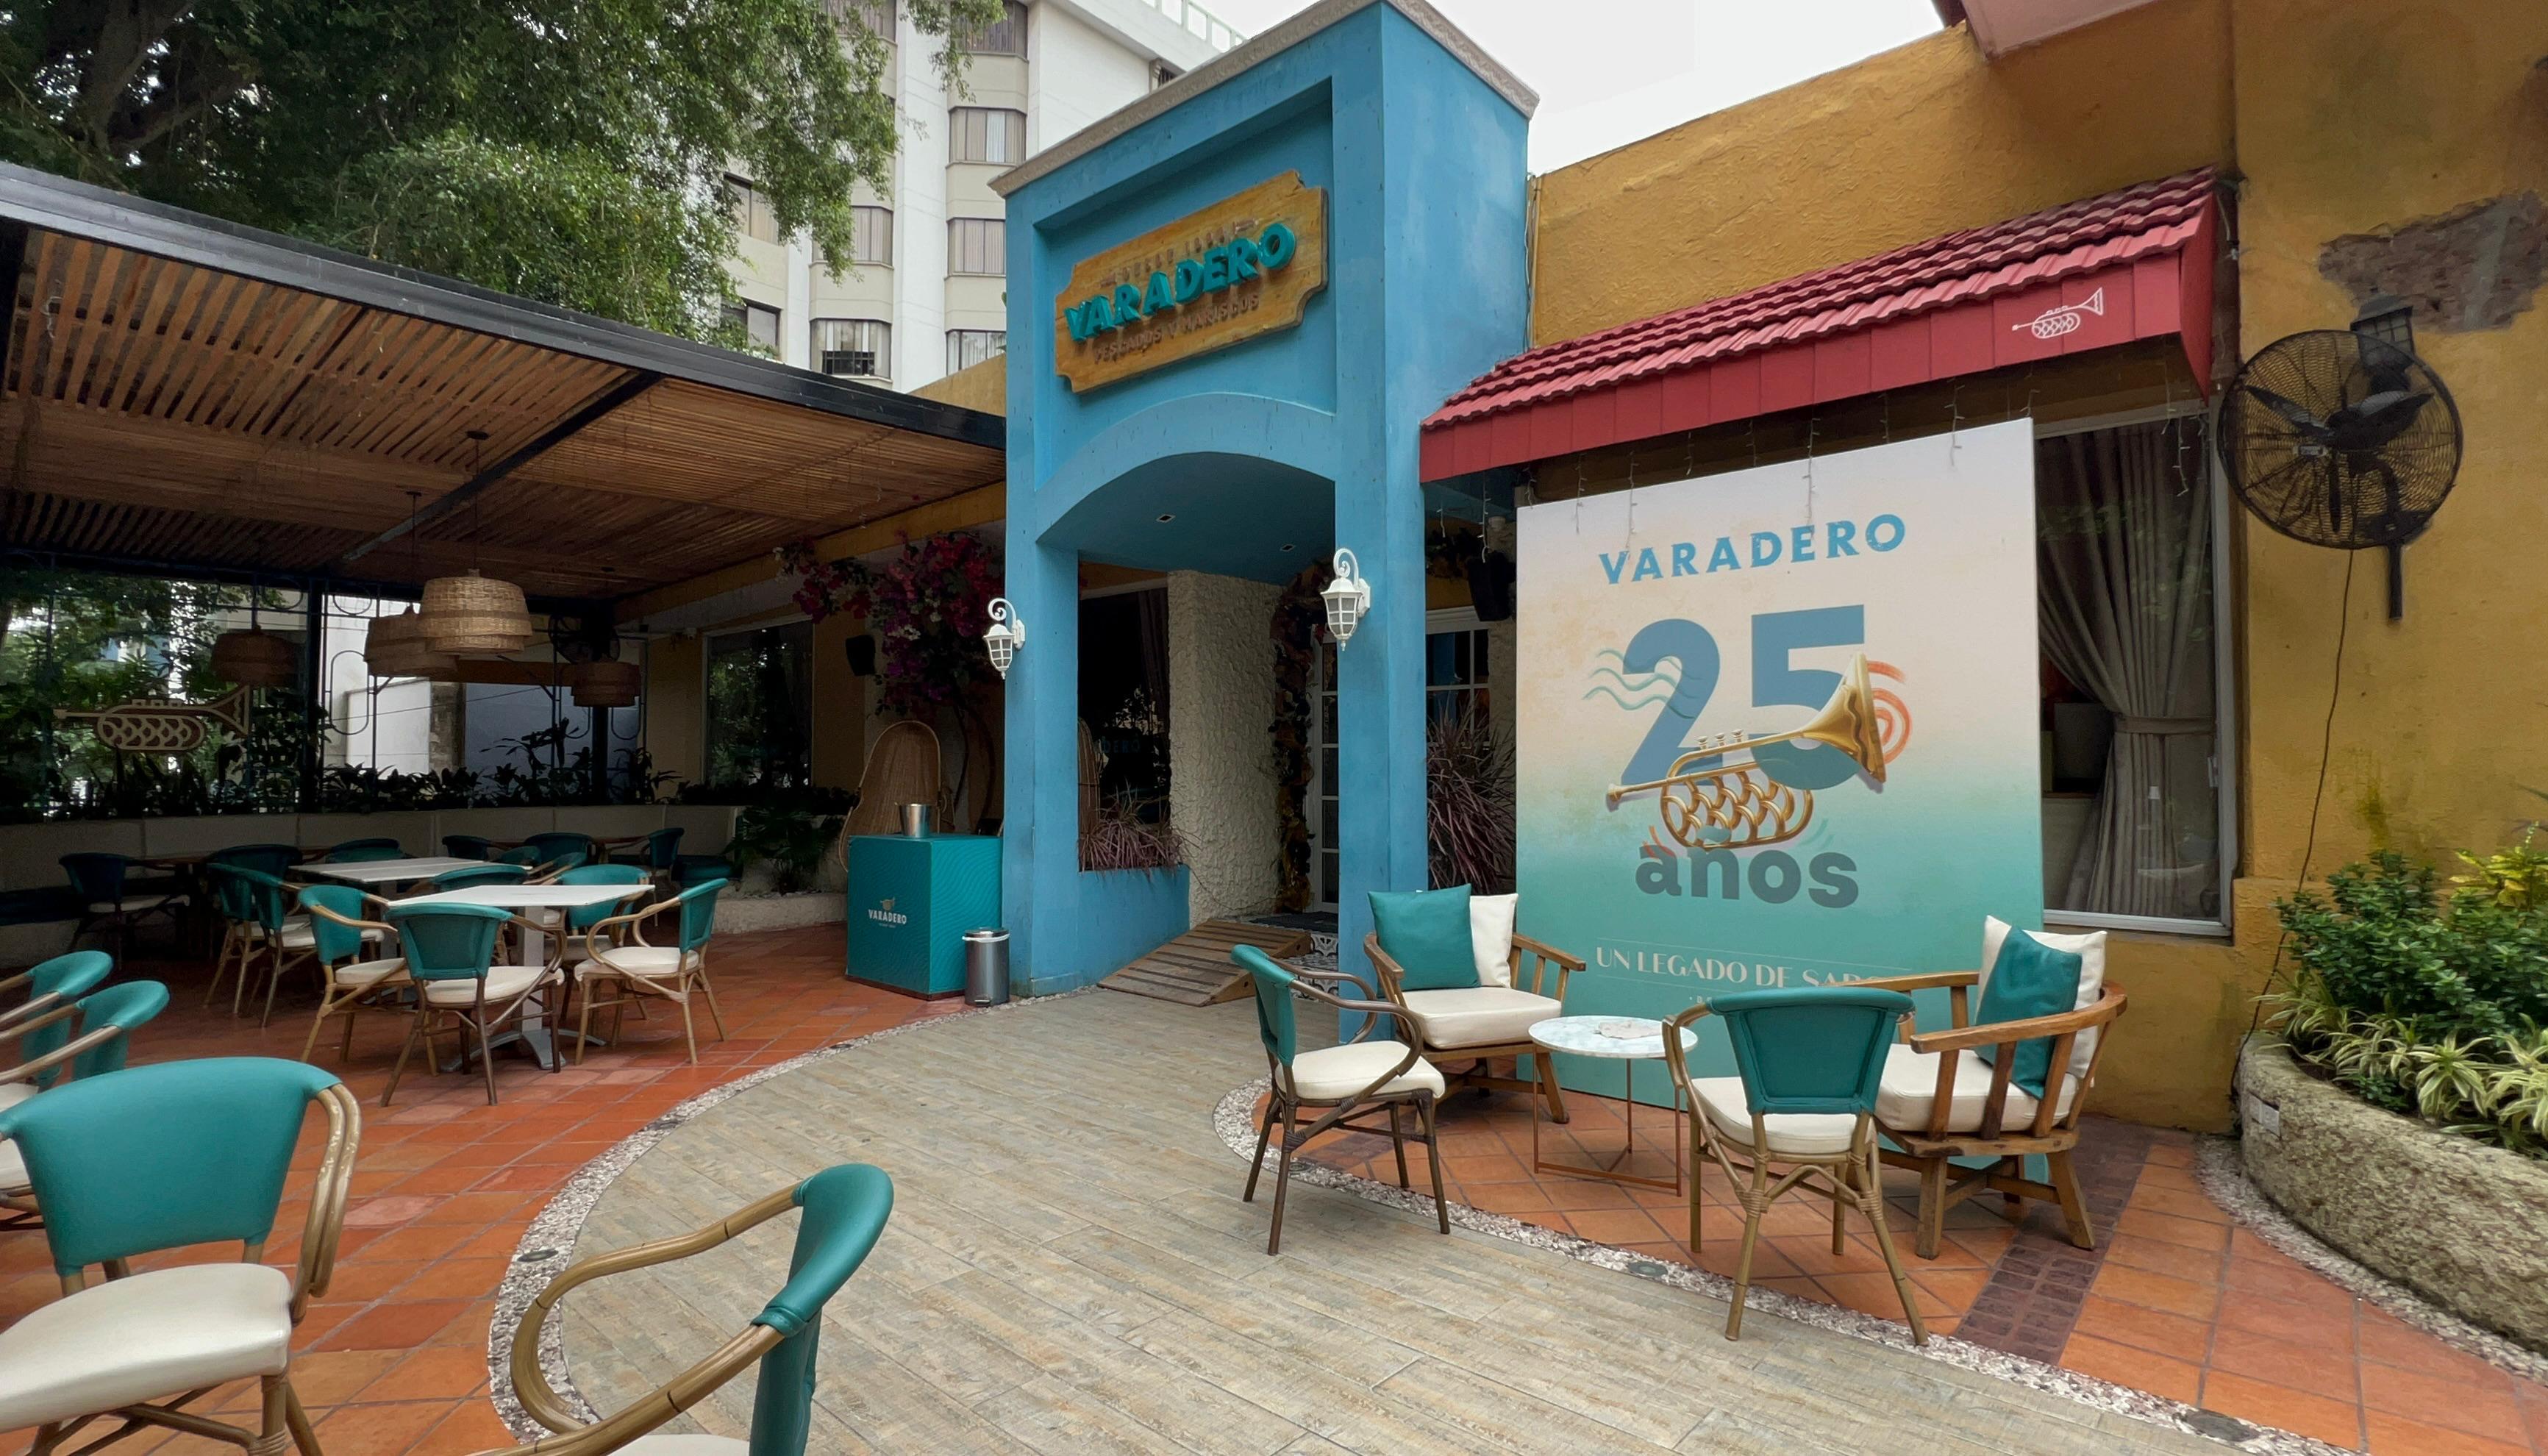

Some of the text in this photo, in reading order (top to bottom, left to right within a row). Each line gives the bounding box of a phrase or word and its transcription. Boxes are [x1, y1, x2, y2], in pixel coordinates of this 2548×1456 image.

[1064, 223, 1296, 343] VARADERO
[1095, 328, 1163, 364] PESCADOS
[1182, 294, 1260, 333] MARISCOS
[1599, 514, 1905, 585] VARADERO
[1621, 604, 1865, 791] 25
[1635, 825, 1860, 908] años
[868, 909, 907, 924] VARADERO
[1596, 947, 1630, 971] UN
[1638, 952, 1747, 983] LEGADO
[1755, 964, 1793, 988] DE
